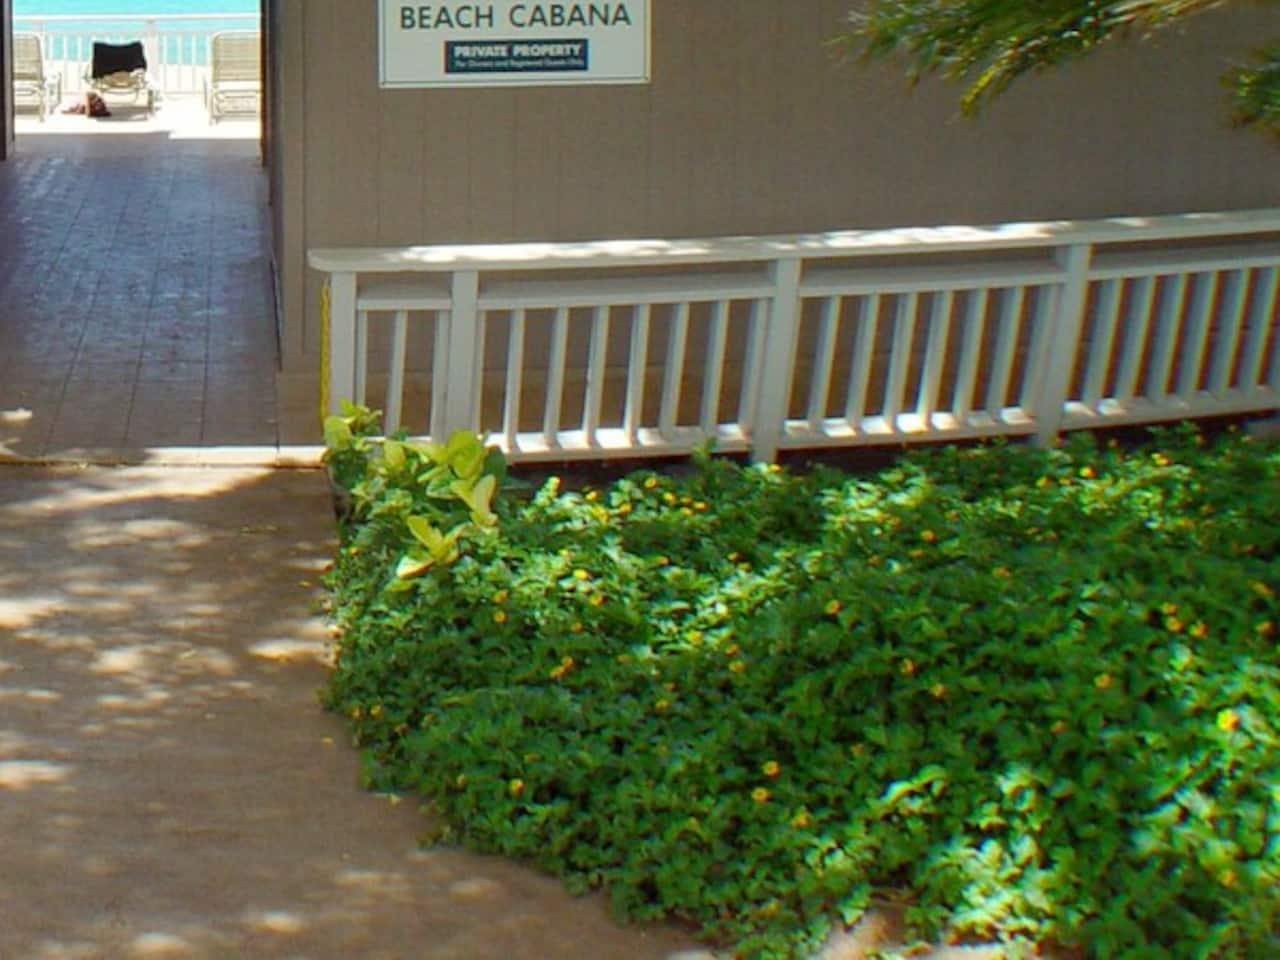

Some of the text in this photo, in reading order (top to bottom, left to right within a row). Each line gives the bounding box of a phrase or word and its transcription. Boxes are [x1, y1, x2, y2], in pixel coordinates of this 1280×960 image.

[400, 4, 632, 29] BEACH CABANA
[454, 43, 581, 57] PRIVATE PROPERTY
